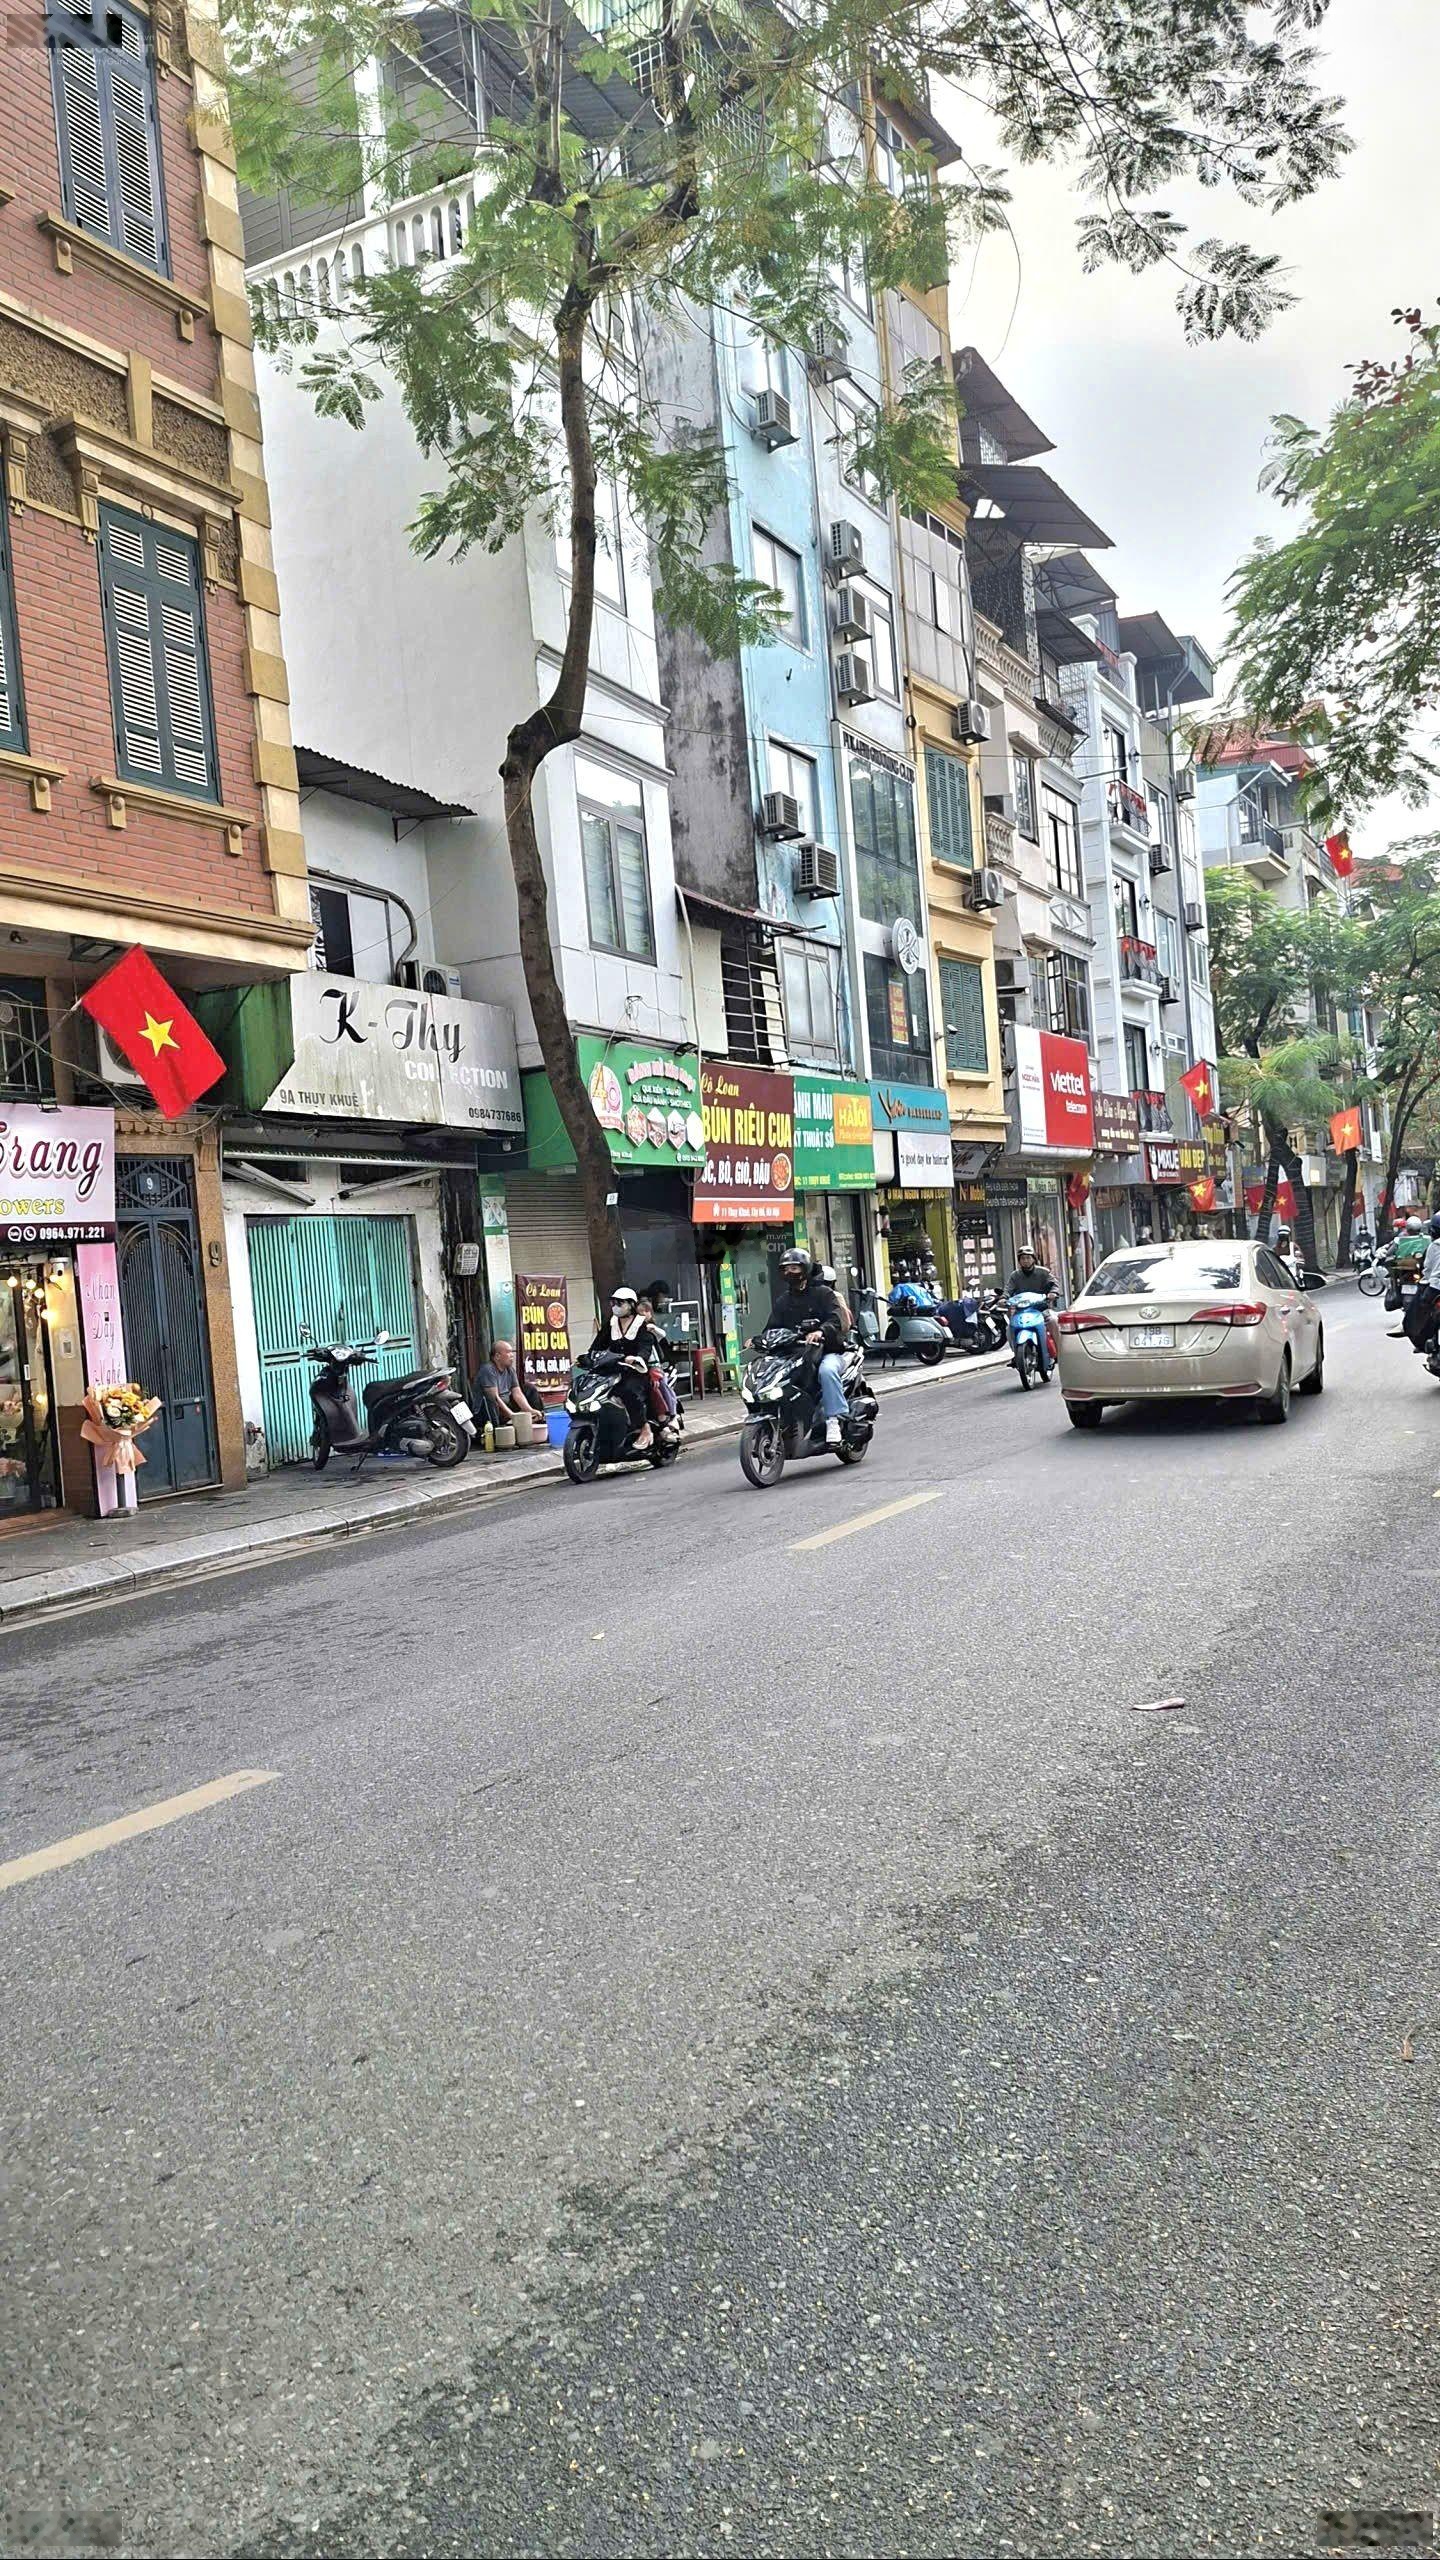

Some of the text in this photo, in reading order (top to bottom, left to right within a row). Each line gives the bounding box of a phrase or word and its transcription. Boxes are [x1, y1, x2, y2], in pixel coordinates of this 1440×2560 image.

[715, 1075, 739, 1096] Loan
[280, 1089, 295, 1105] 9A
[468, 1107, 522, 1123] 0984737686
[702, 1098, 791, 1148] BÚN RIÊU CUA
[146, 1177, 154, 1191] 9
[753, 1158, 770, 1190] ĐẬU
[39, 1226, 105, 1240] 0964.971.221
[209, 1240, 222, 1267] 9
[526, 1283, 561, 1297] Cô Loan
[522, 1302, 545, 1324] BÚN
[524, 1328, 568, 1350] RIÊU CUA
